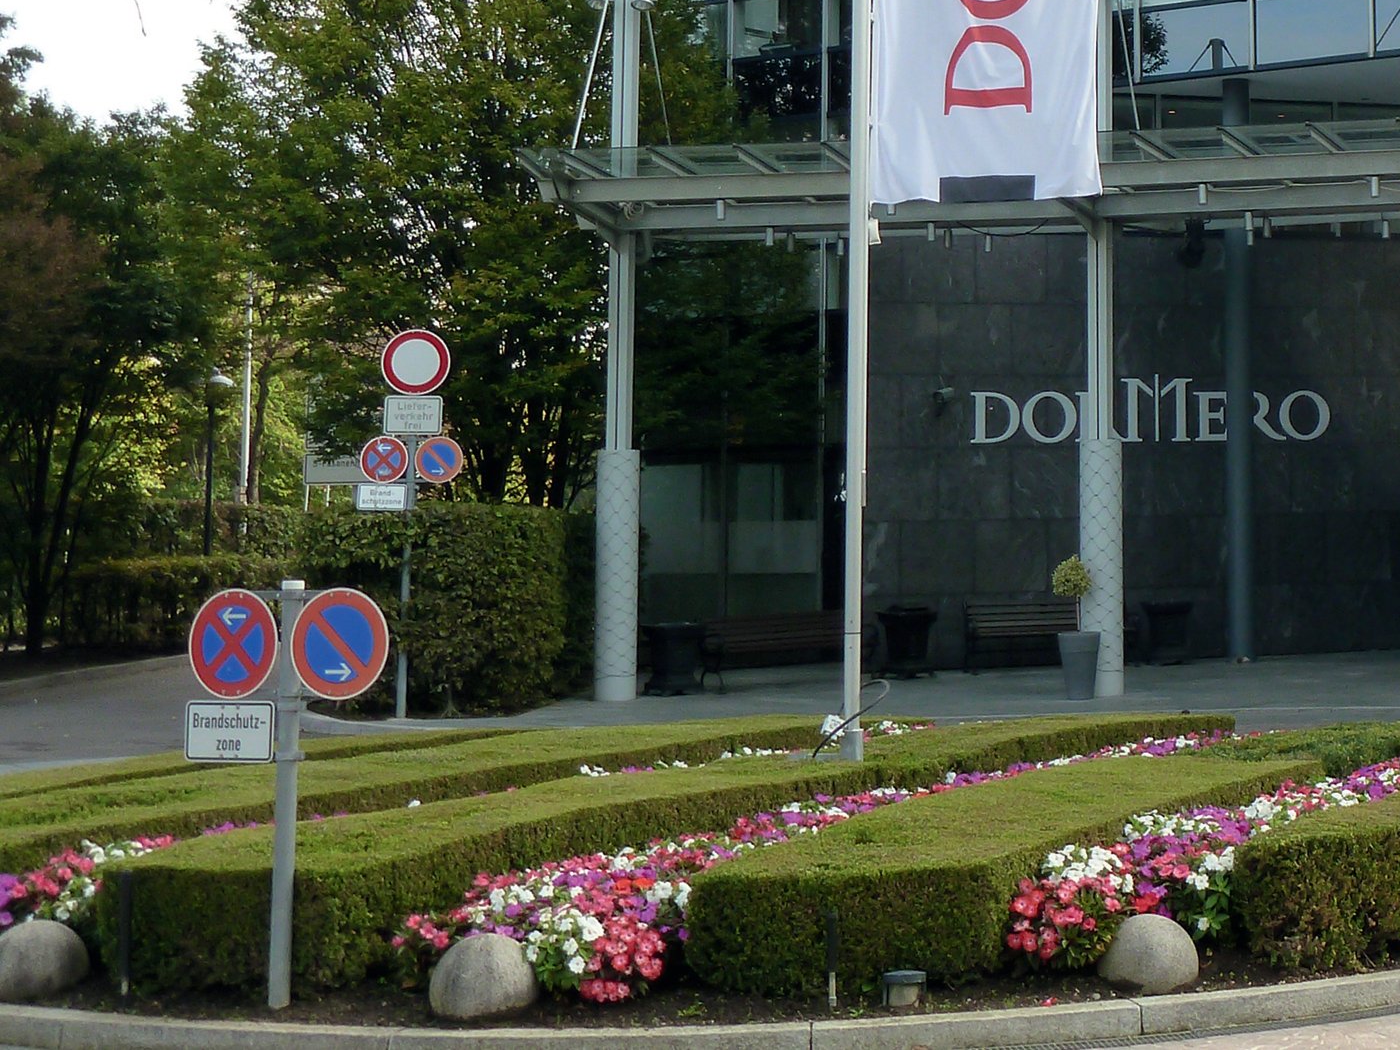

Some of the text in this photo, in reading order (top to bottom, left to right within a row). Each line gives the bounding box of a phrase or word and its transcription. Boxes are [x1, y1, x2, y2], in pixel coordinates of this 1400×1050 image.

[397, 401, 432, 411] Liefer-
[394, 412, 434, 421] verkehr
[404, 421, 422, 430] frei
[193, 712, 267, 730] Brandschutz-
[215, 738, 241, 751] zone
